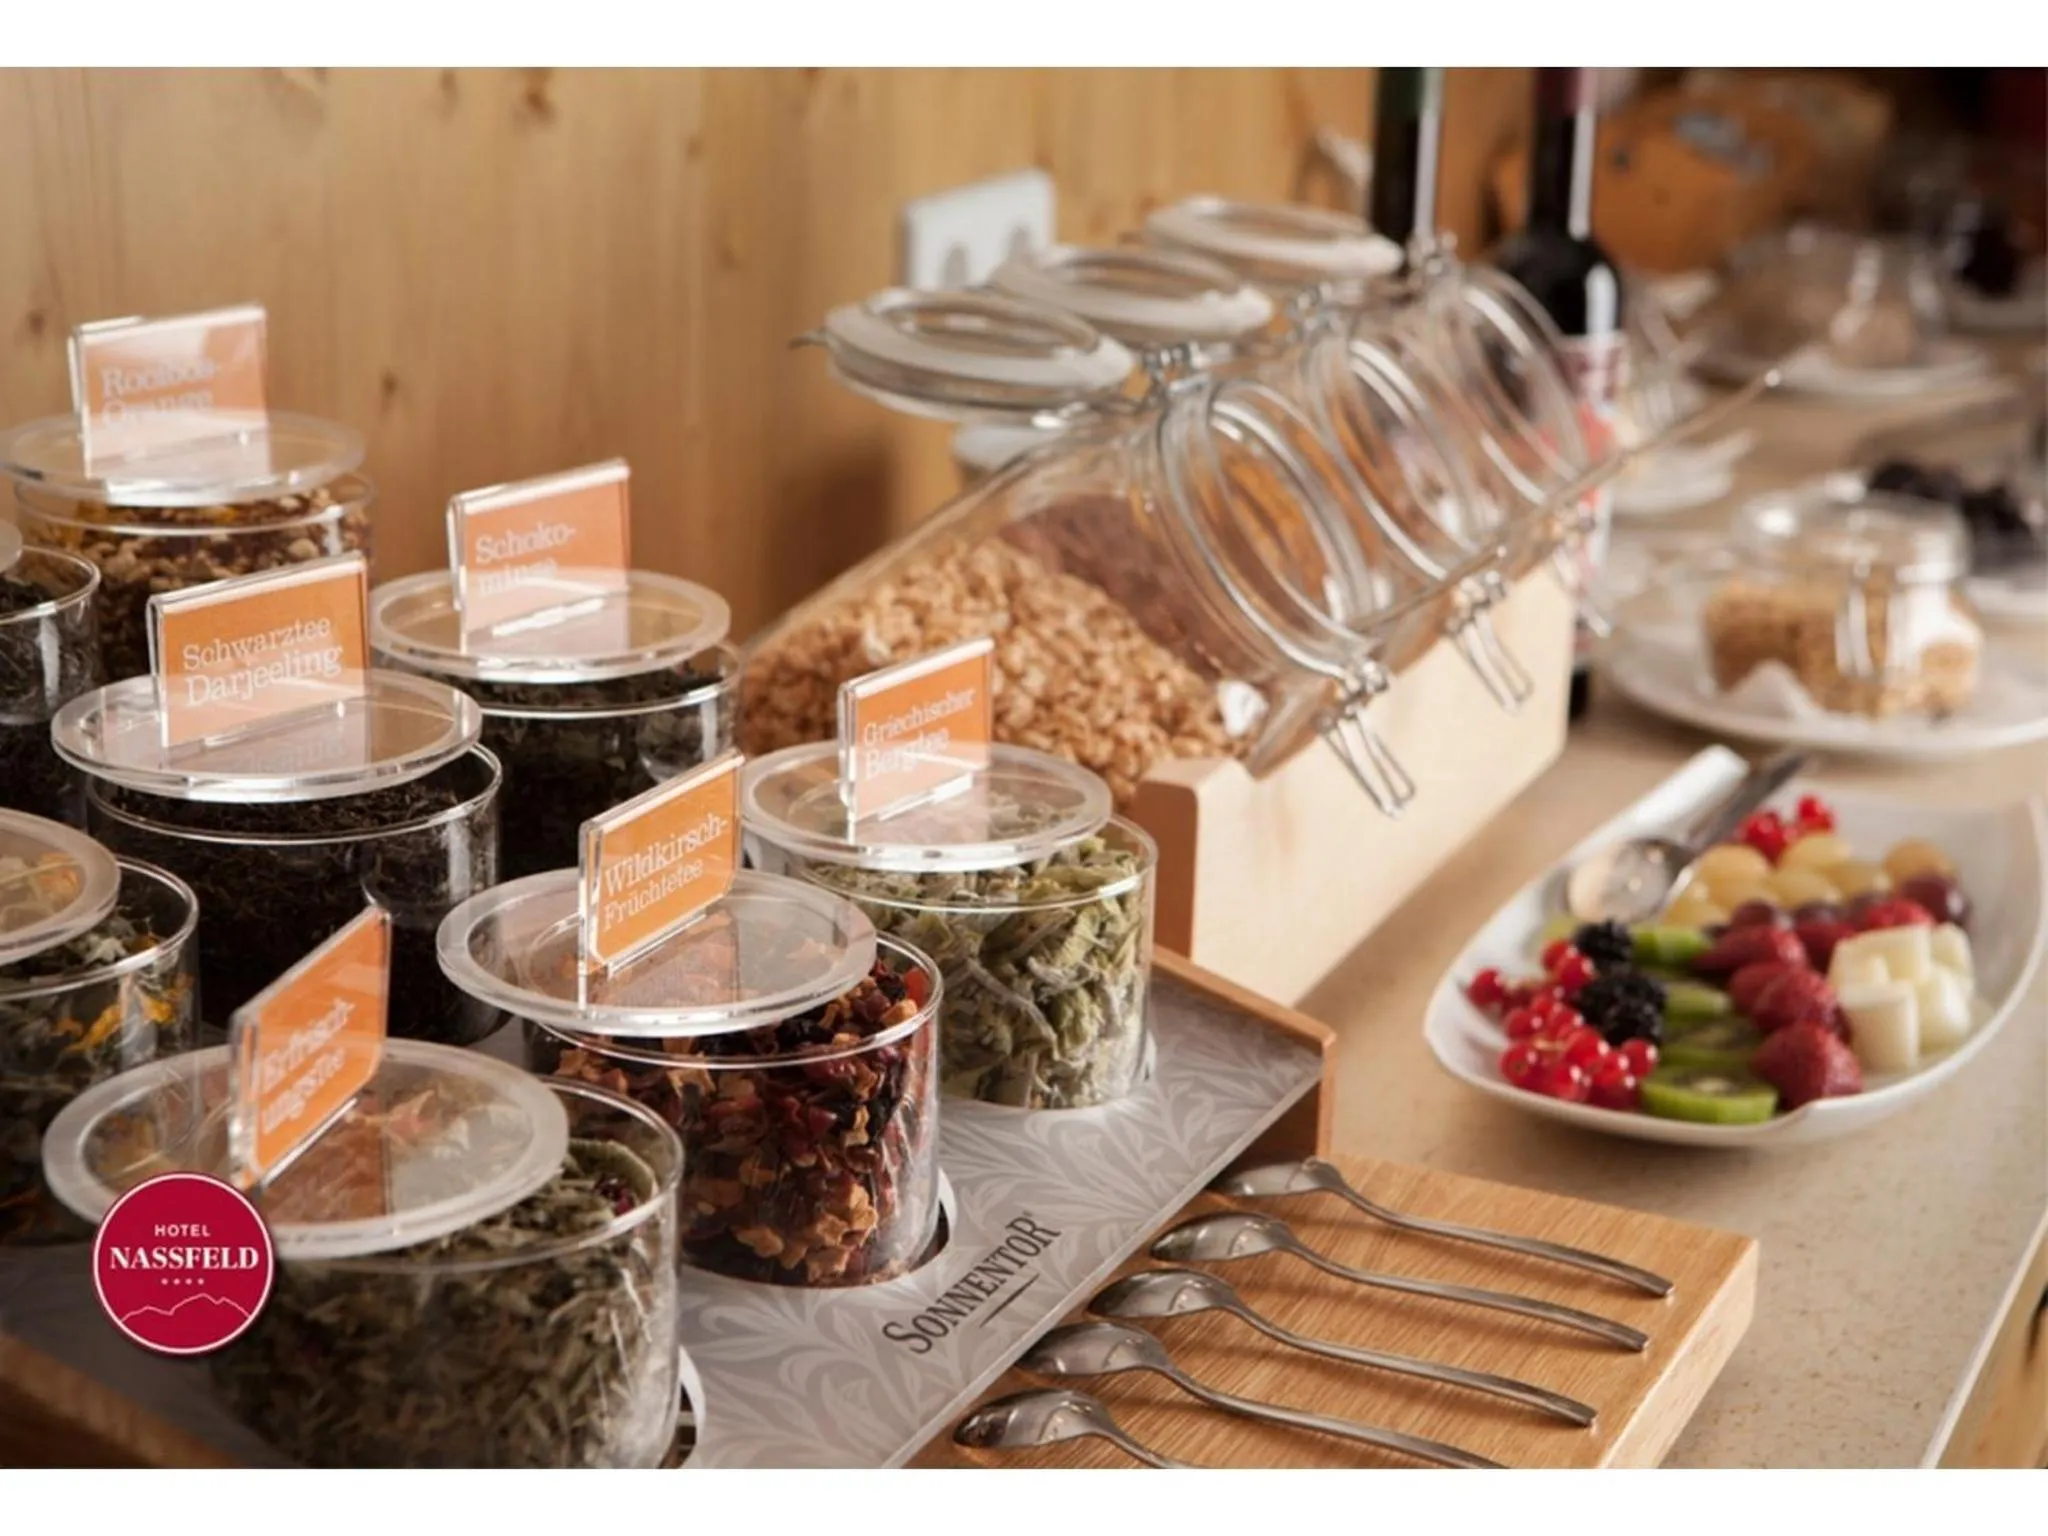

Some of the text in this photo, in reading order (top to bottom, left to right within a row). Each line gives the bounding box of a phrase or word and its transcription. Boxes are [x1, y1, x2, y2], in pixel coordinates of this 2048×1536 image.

[475, 520, 577, 564] Schoko-
[182, 616, 332, 671] Schwarztee
[185, 646, 344, 708] Darjeeling
[604, 812, 728, 896] Wildkirsch-
[604, 859, 704, 932] Früchtetee
